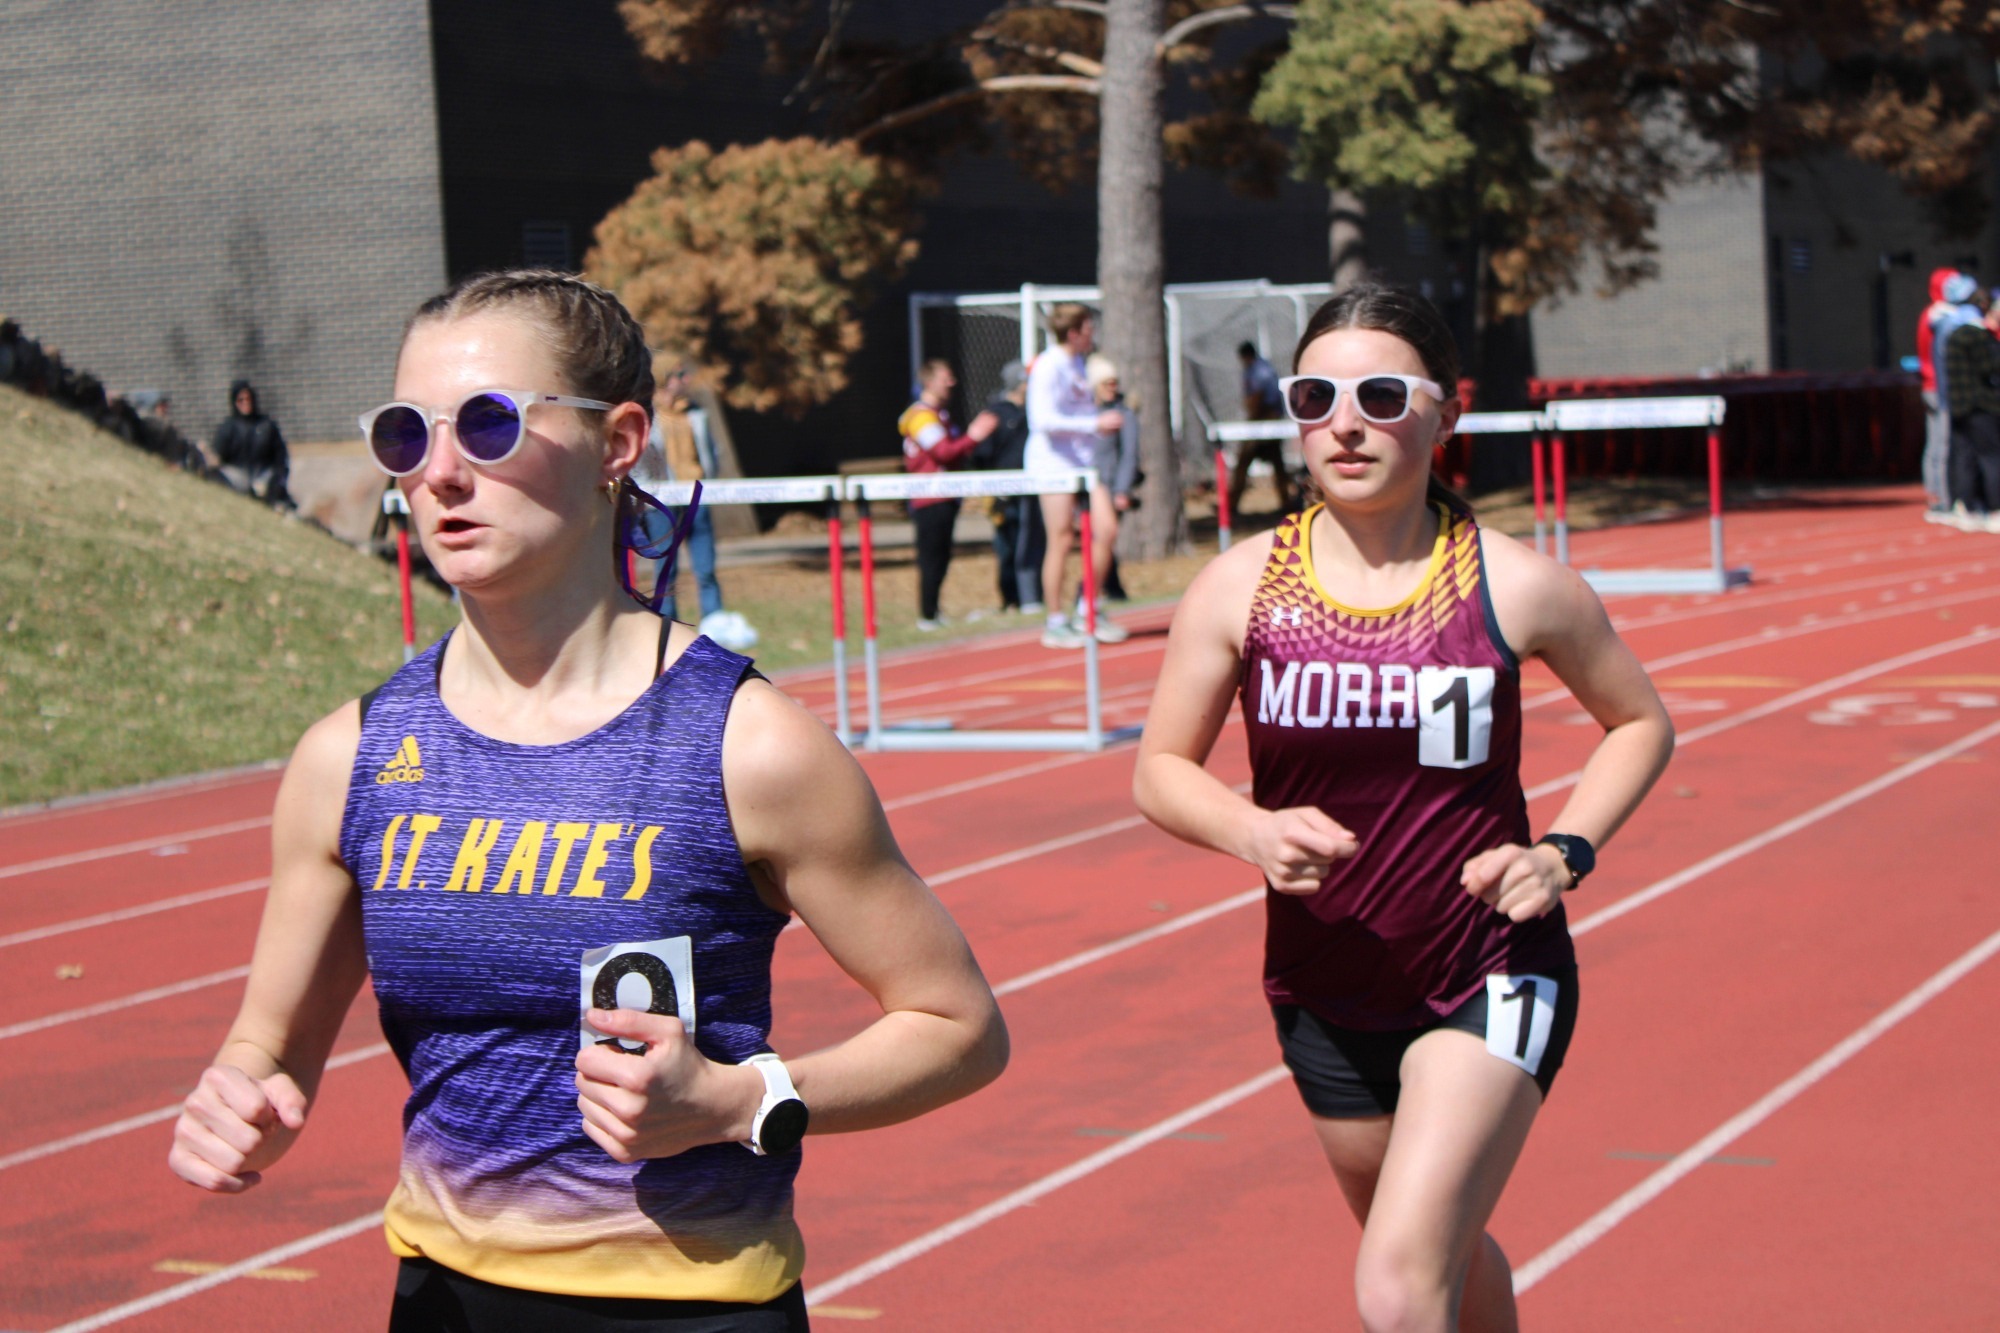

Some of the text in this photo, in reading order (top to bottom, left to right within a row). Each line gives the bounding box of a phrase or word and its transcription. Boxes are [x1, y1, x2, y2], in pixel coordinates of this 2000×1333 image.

[1258, 659, 1467, 728] MORR
[1432, 676, 1470, 762] 1
[375, 766, 425, 785] adidas
[373, 814, 665, 901] ST. KATE'S
[1501, 979, 1537, 1061] 1
